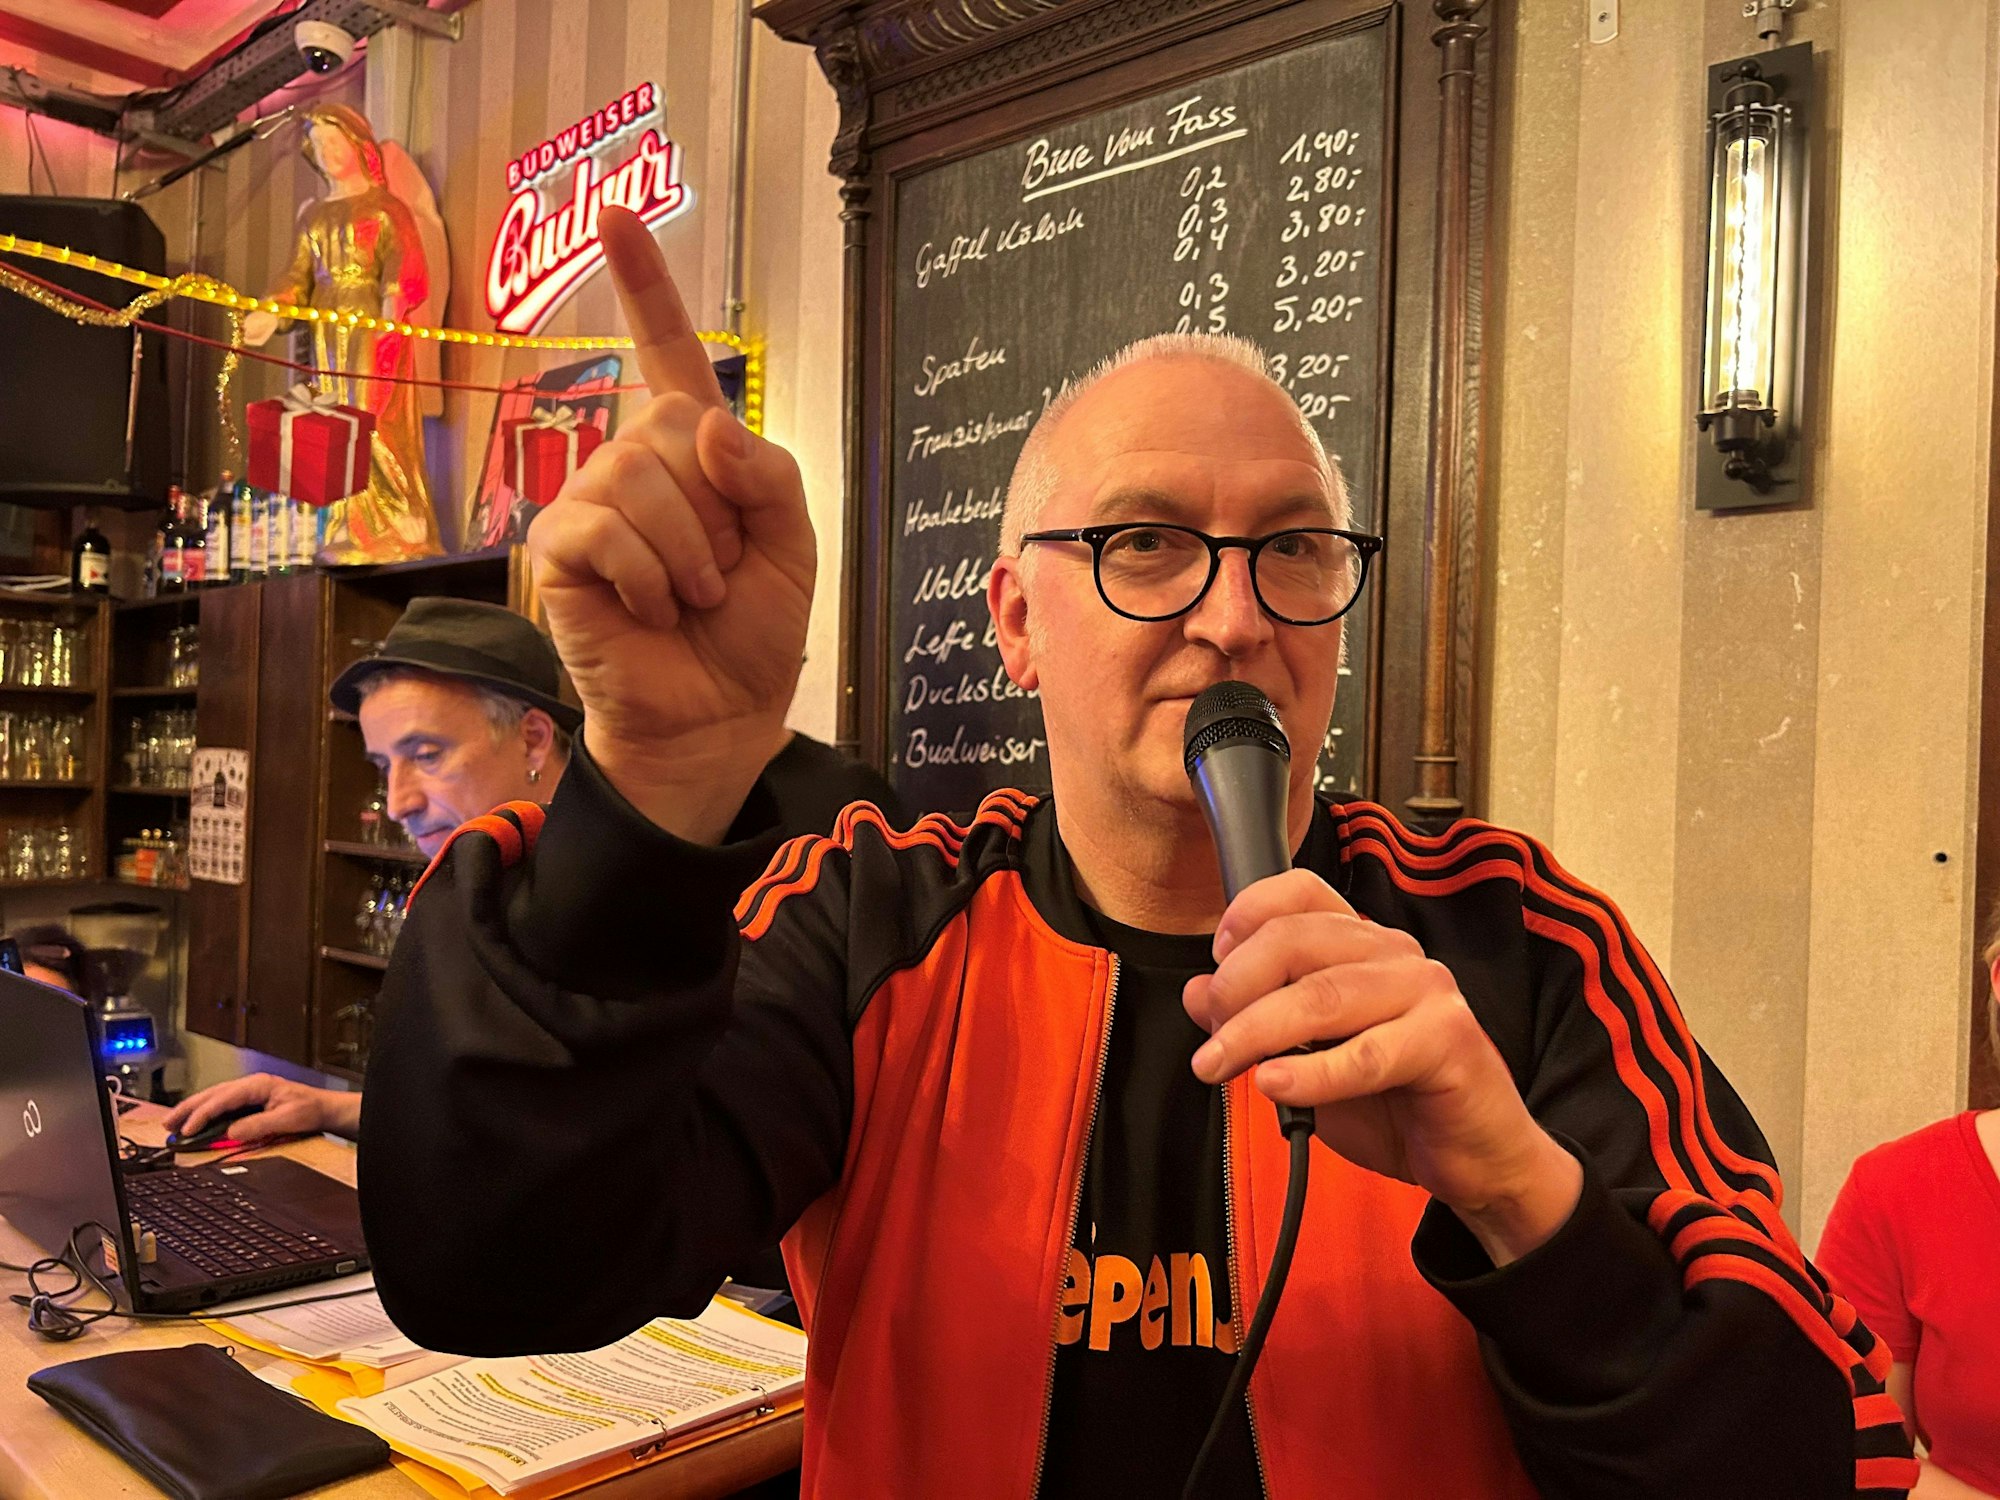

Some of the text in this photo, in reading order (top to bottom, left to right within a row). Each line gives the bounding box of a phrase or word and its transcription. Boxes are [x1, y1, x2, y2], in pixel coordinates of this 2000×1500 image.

[506, 81, 656, 192] BUDWEISER
[1021, 138, 1094, 190] Biere
[1166, 95, 1237, 145] Fass
[915, 224, 990, 289] Gaffel
[996, 206, 1085, 253] Kölsch
[1180, 165, 1228, 202] 0,2
[1173, 223, 1229, 263] 0,4
[1177, 197, 1228, 239] 0,3
[913, 336, 1006, 397] Spaten
[1179, 272, 1229, 310] 0,3
[904, 620, 975, 665] Leffe
[905, 725, 1046, 769] Budweiser
